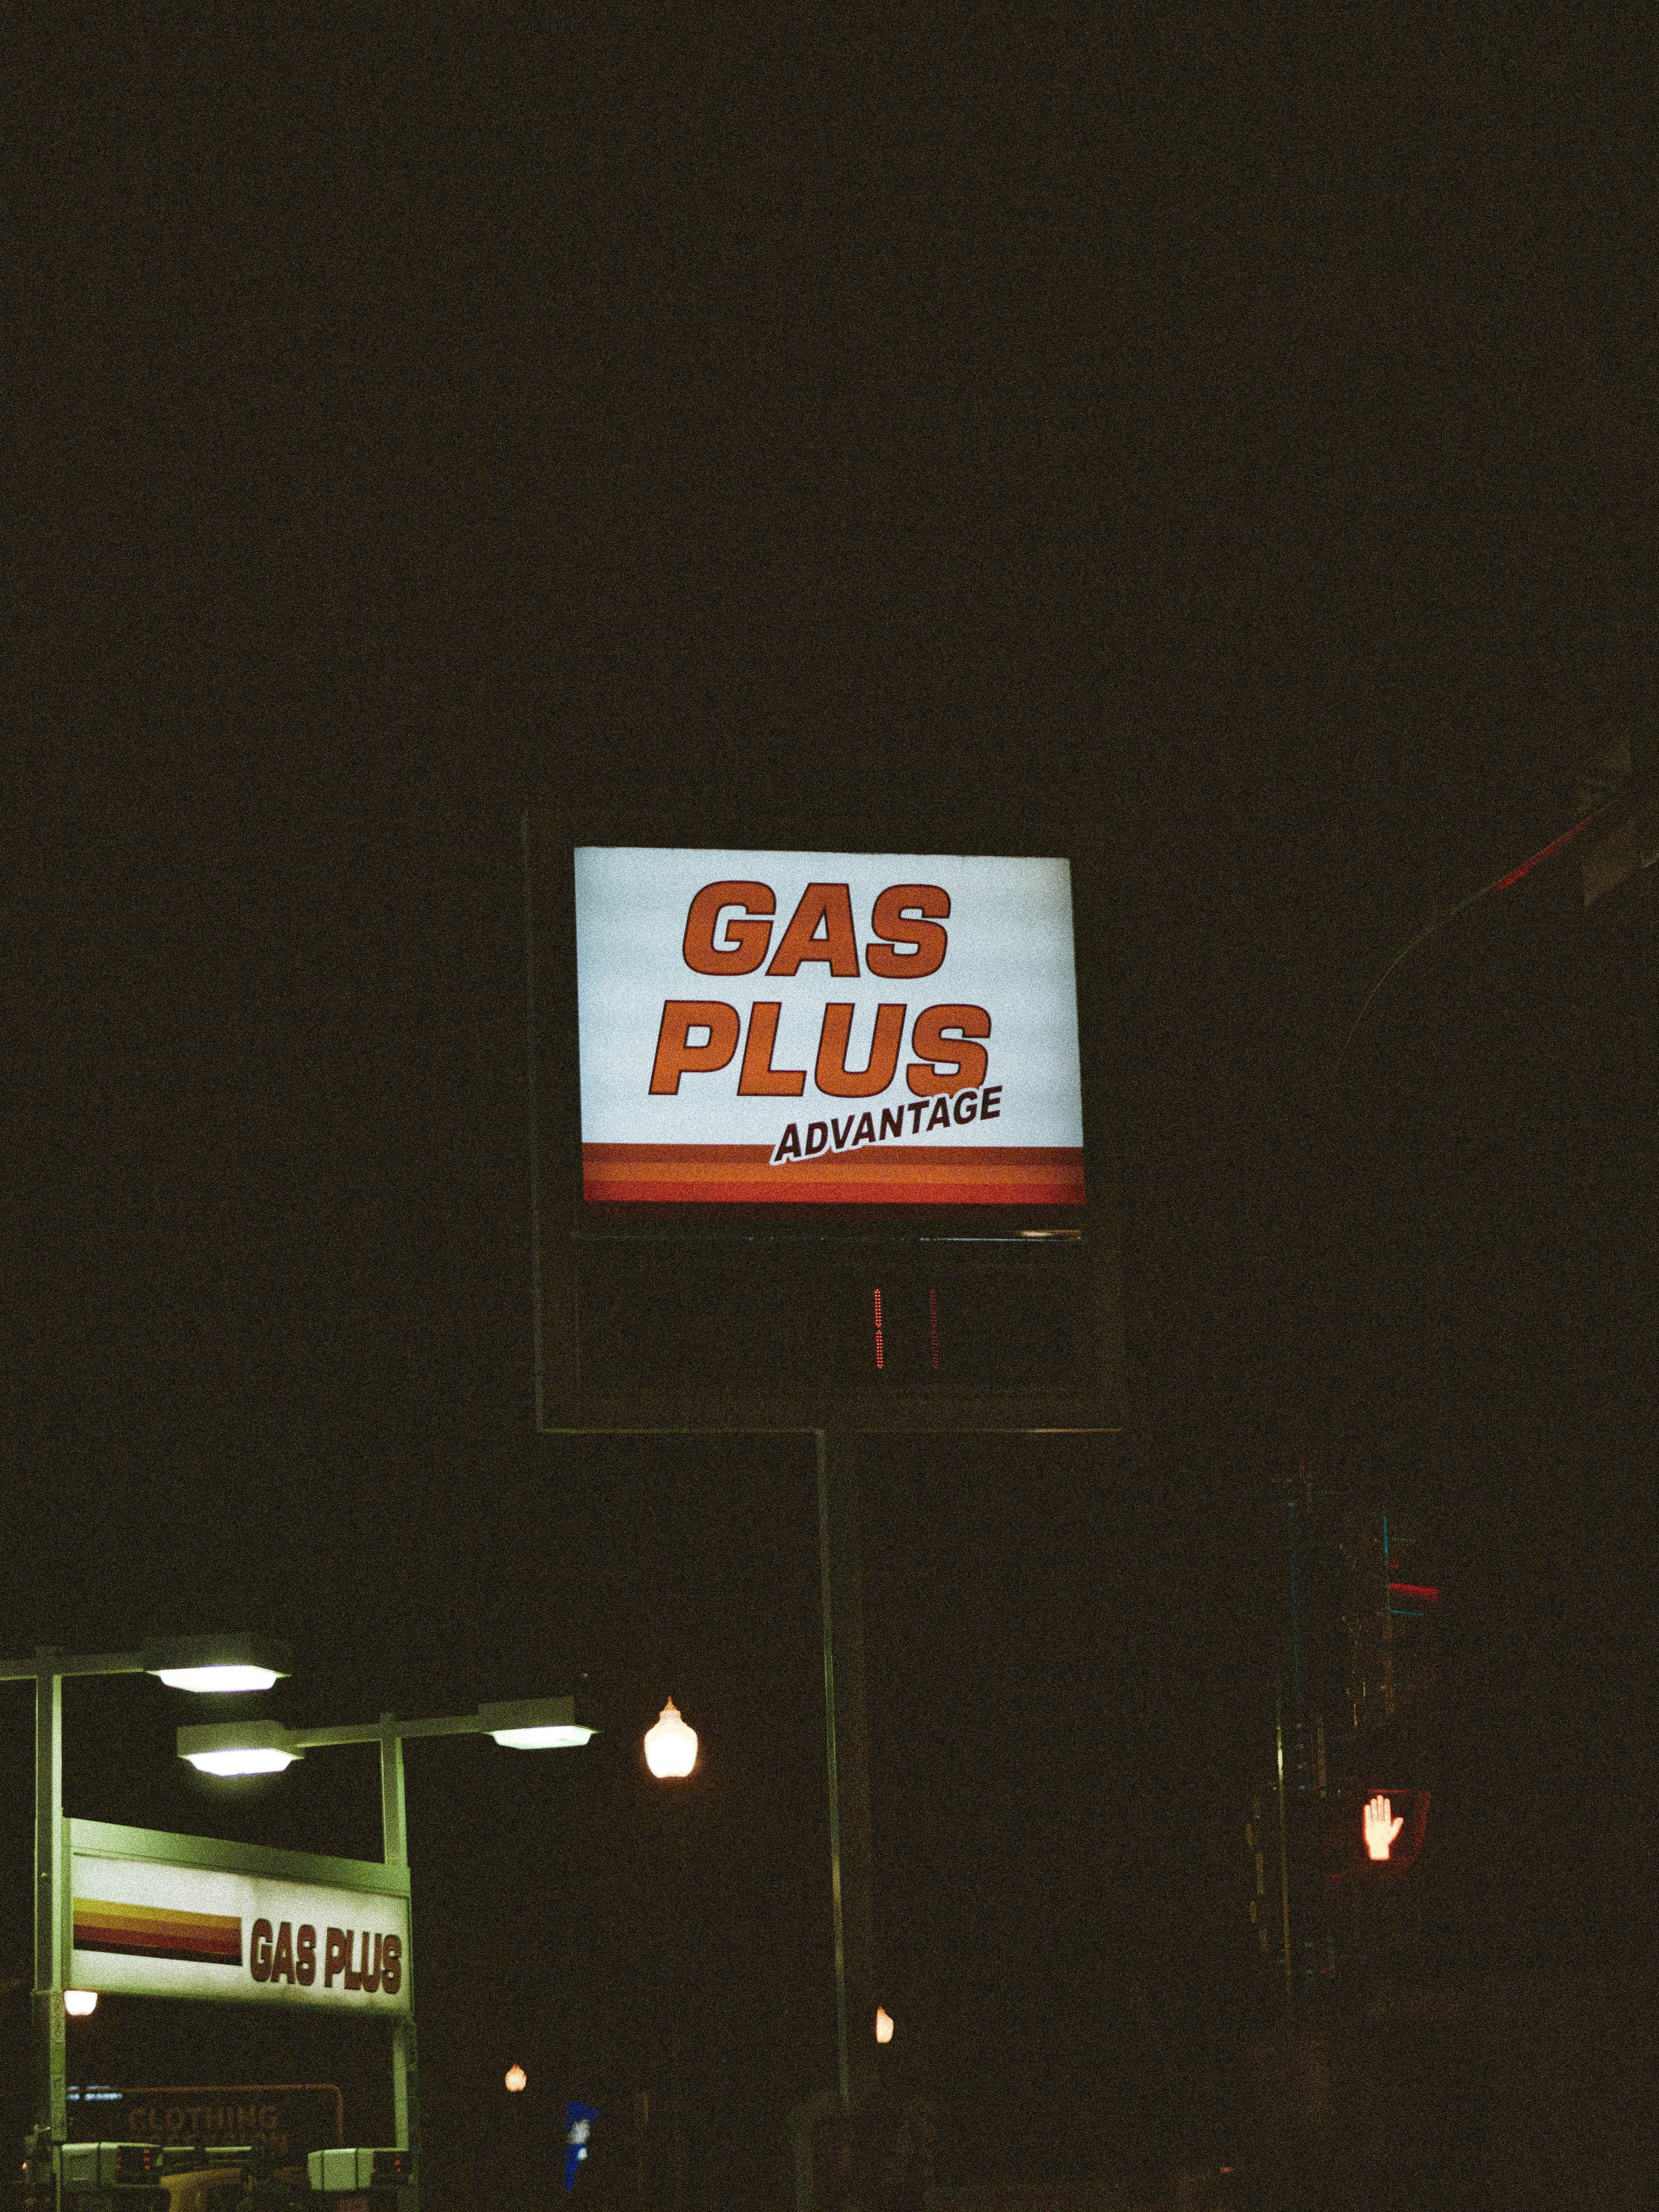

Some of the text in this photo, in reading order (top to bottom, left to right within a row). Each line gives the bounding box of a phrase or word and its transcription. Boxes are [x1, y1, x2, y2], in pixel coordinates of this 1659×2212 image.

[682, 880, 951, 979] GAS
[648, 1000, 992, 1098] PLUS
[773, 1085, 1003, 1162] ADVANTAGE
[250, 1918, 402, 1994] GAS PLUS
[129, 2105, 278, 2130] CLOTHING
